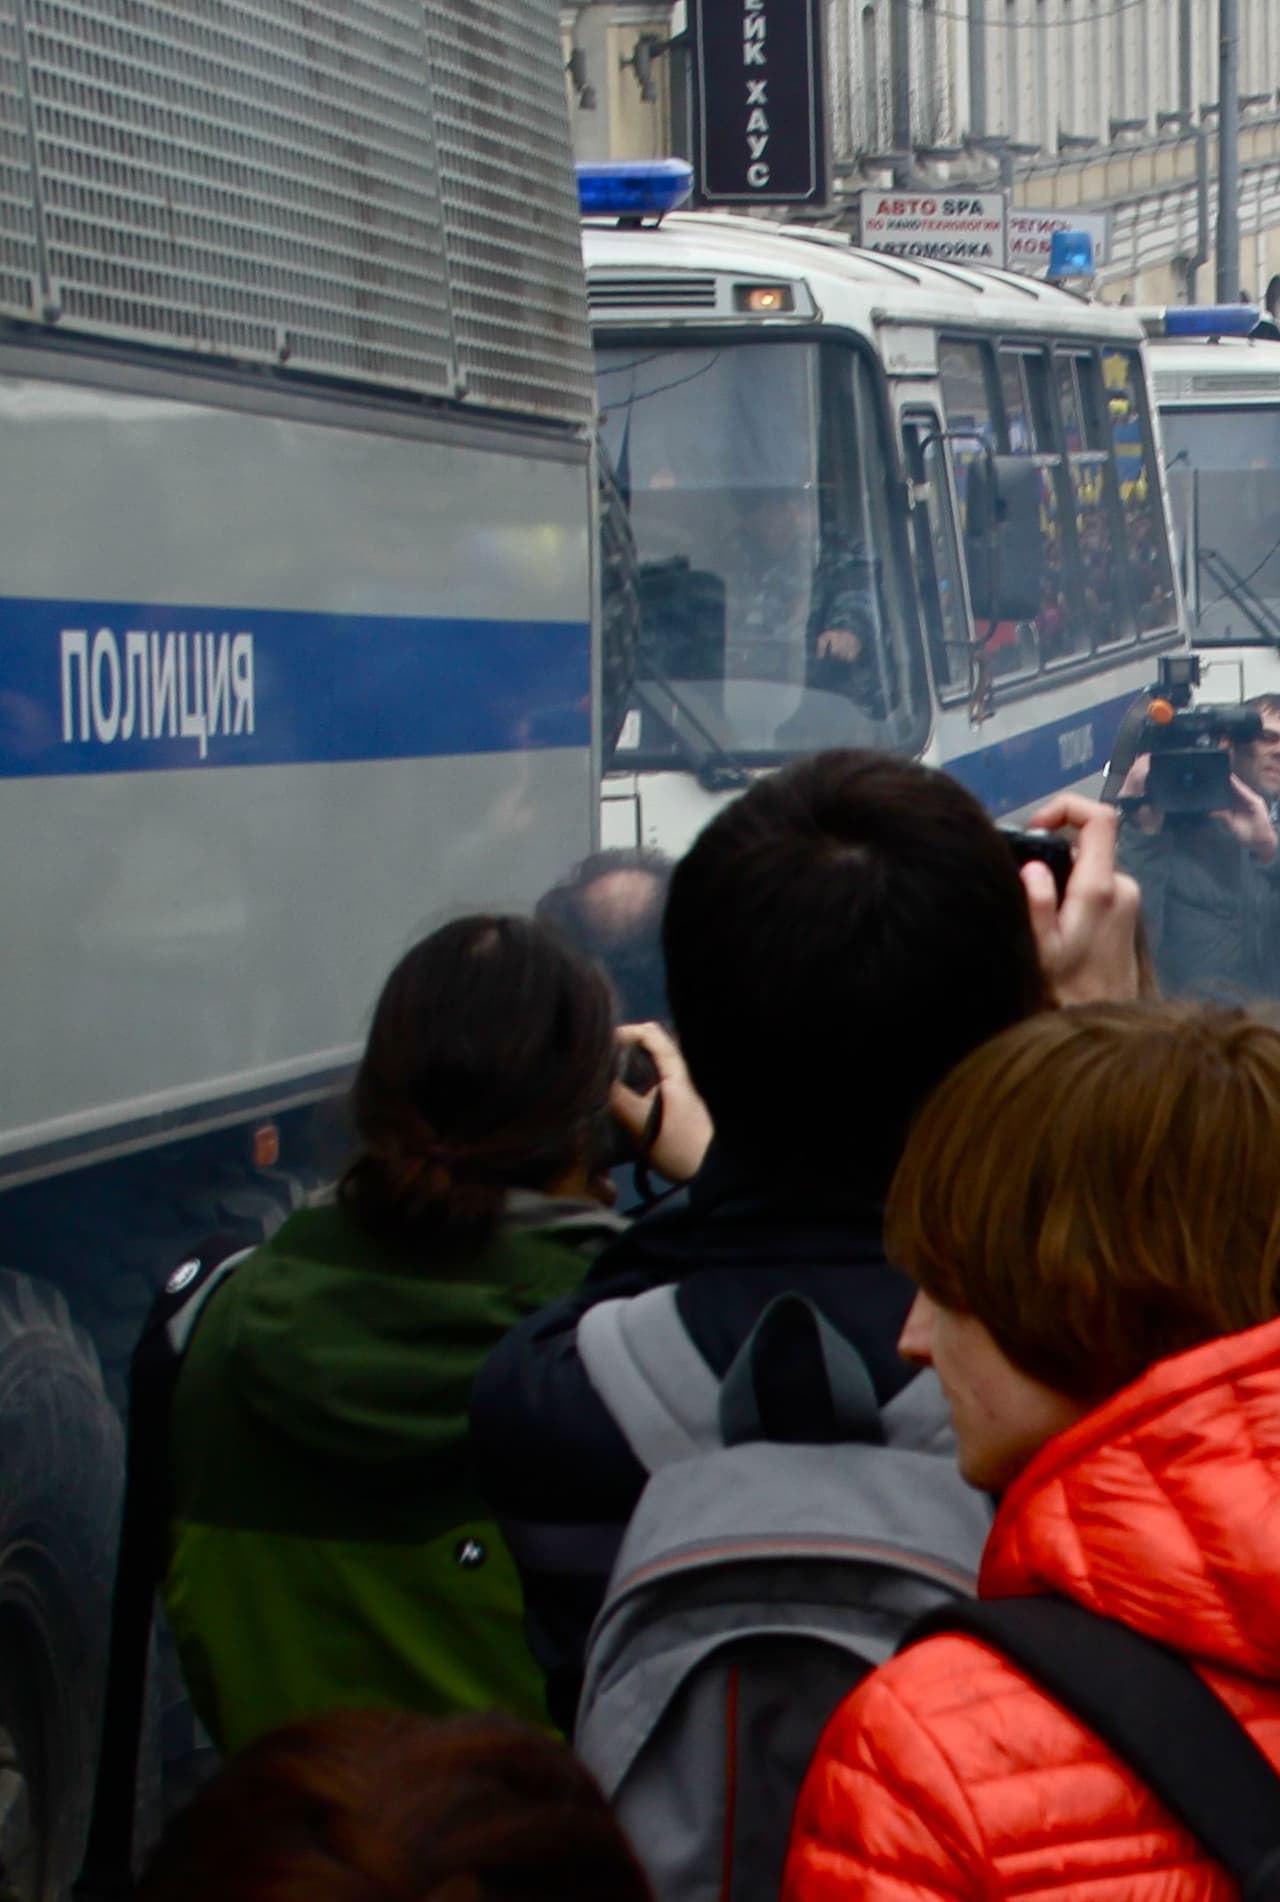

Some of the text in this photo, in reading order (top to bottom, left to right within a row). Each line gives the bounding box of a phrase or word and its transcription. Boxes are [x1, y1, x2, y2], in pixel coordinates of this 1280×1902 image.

[745, 79, 770, 187] ХАУС
[876, 200, 984, 216] АВТО SPA
[60, 627, 255, 760] ПОЛИЦИЯ
